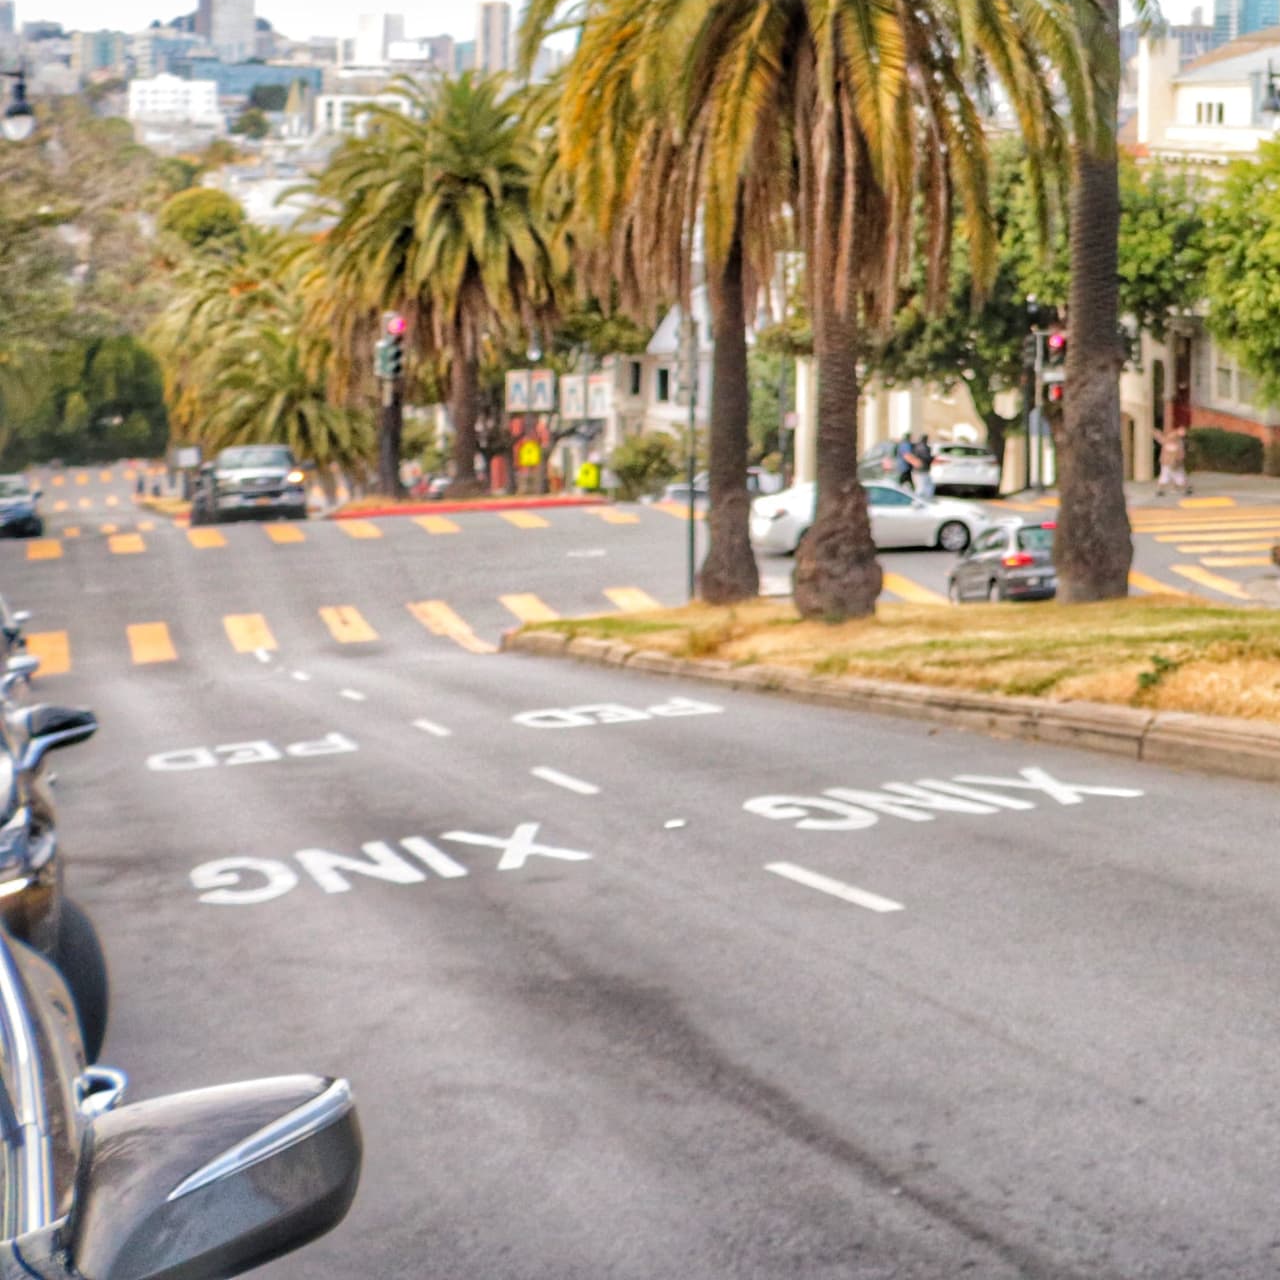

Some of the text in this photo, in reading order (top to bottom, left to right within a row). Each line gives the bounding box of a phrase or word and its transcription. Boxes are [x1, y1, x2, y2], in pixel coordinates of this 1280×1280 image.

[512, 695, 729, 729] PED
[146, 732, 358, 771] PED
[742, 765, 1145, 831] XING
[189, 822, 593, 905] XING
